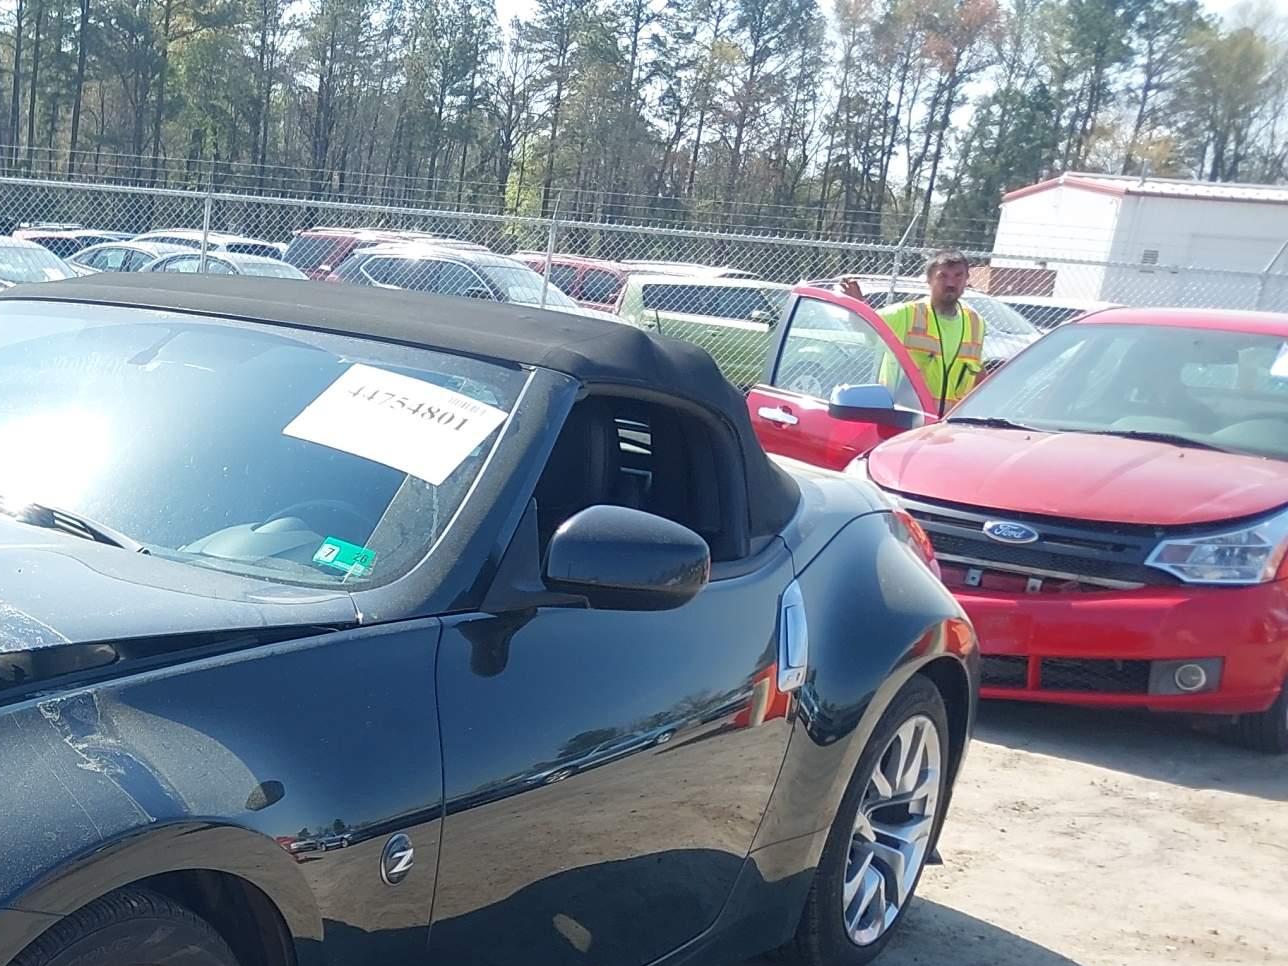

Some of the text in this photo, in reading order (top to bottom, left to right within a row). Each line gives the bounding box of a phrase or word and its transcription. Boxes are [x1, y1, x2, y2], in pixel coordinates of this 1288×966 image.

[349, 384, 471, 432] 44754801
[993, 523, 1026, 539] Ford
[324, 547, 336, 558] 7
[388, 847, 415, 875] Z
